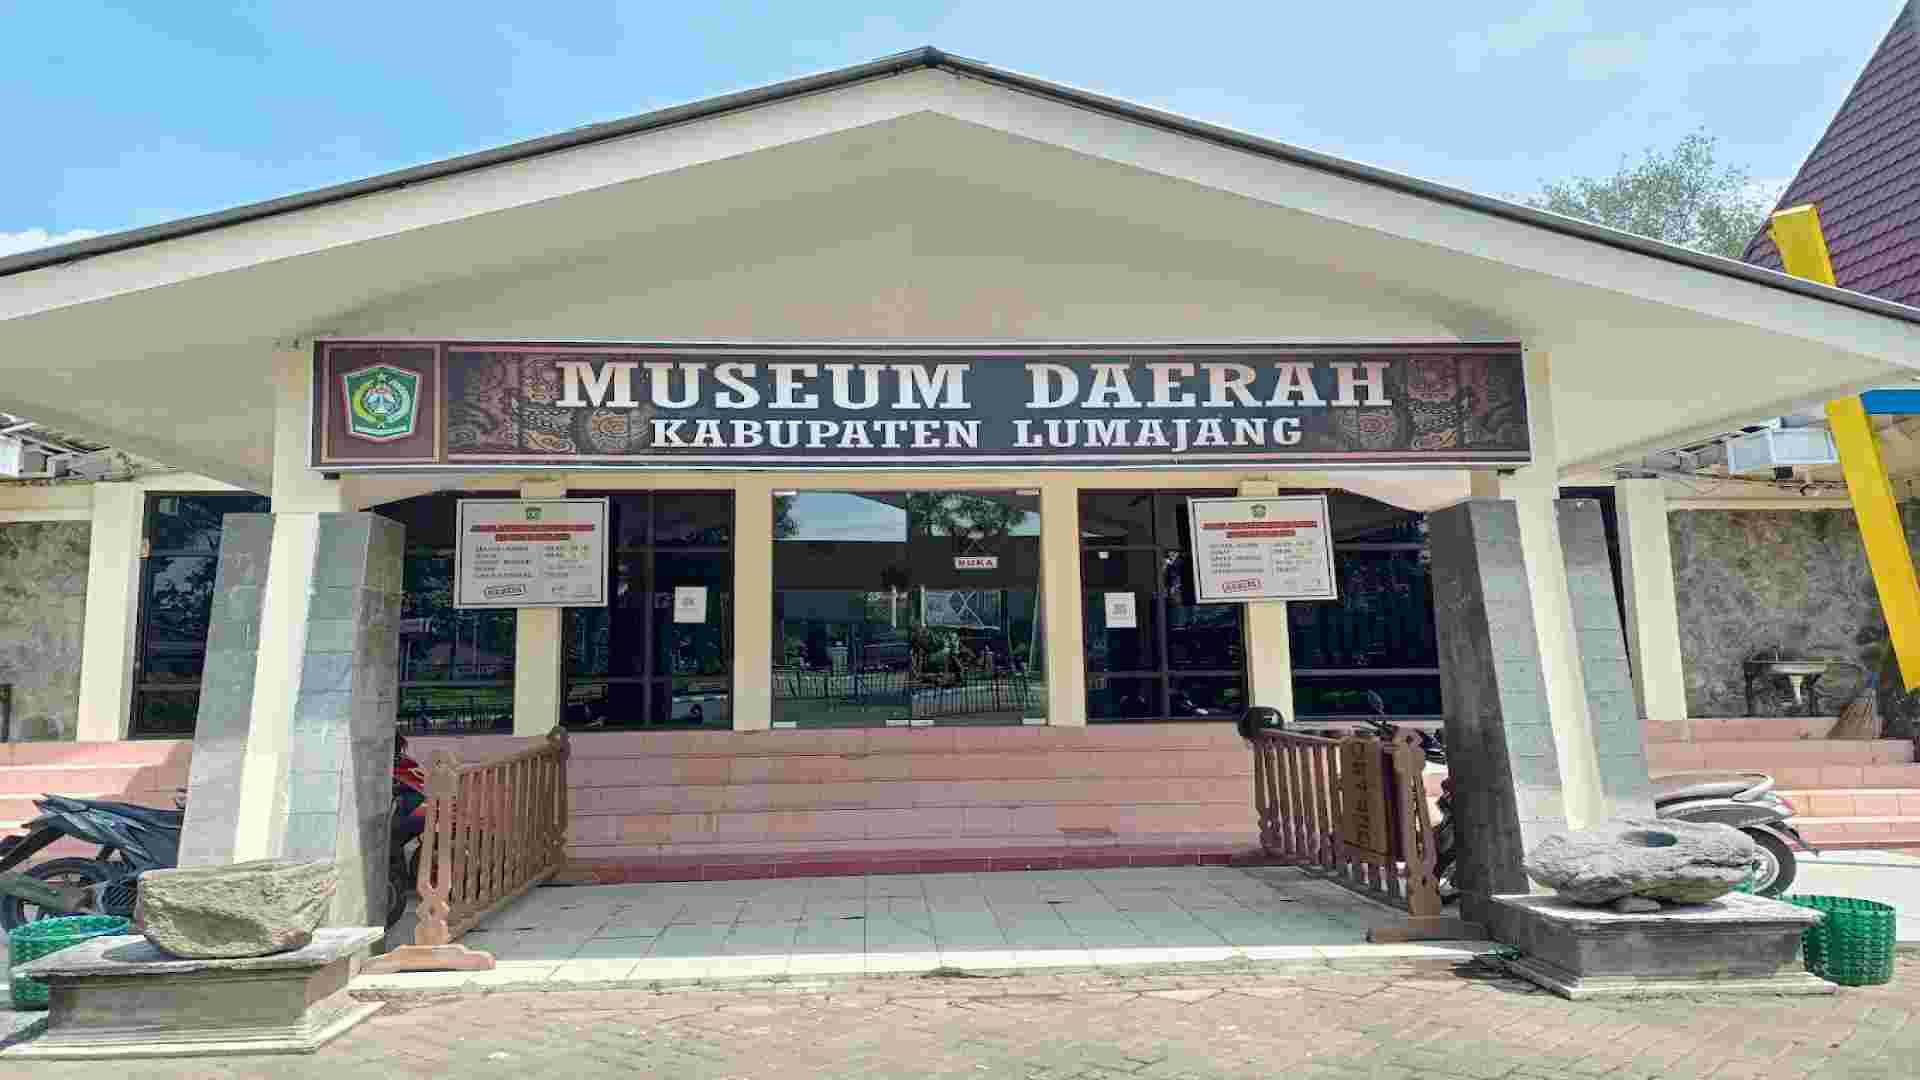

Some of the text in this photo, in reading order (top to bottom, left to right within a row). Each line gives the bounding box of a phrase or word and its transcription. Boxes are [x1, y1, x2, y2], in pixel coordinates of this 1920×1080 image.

[556, 361, 1392, 409] MUSEUM DAERAH
[650, 417, 1302, 452] KABUPATEN LUMAJANG
